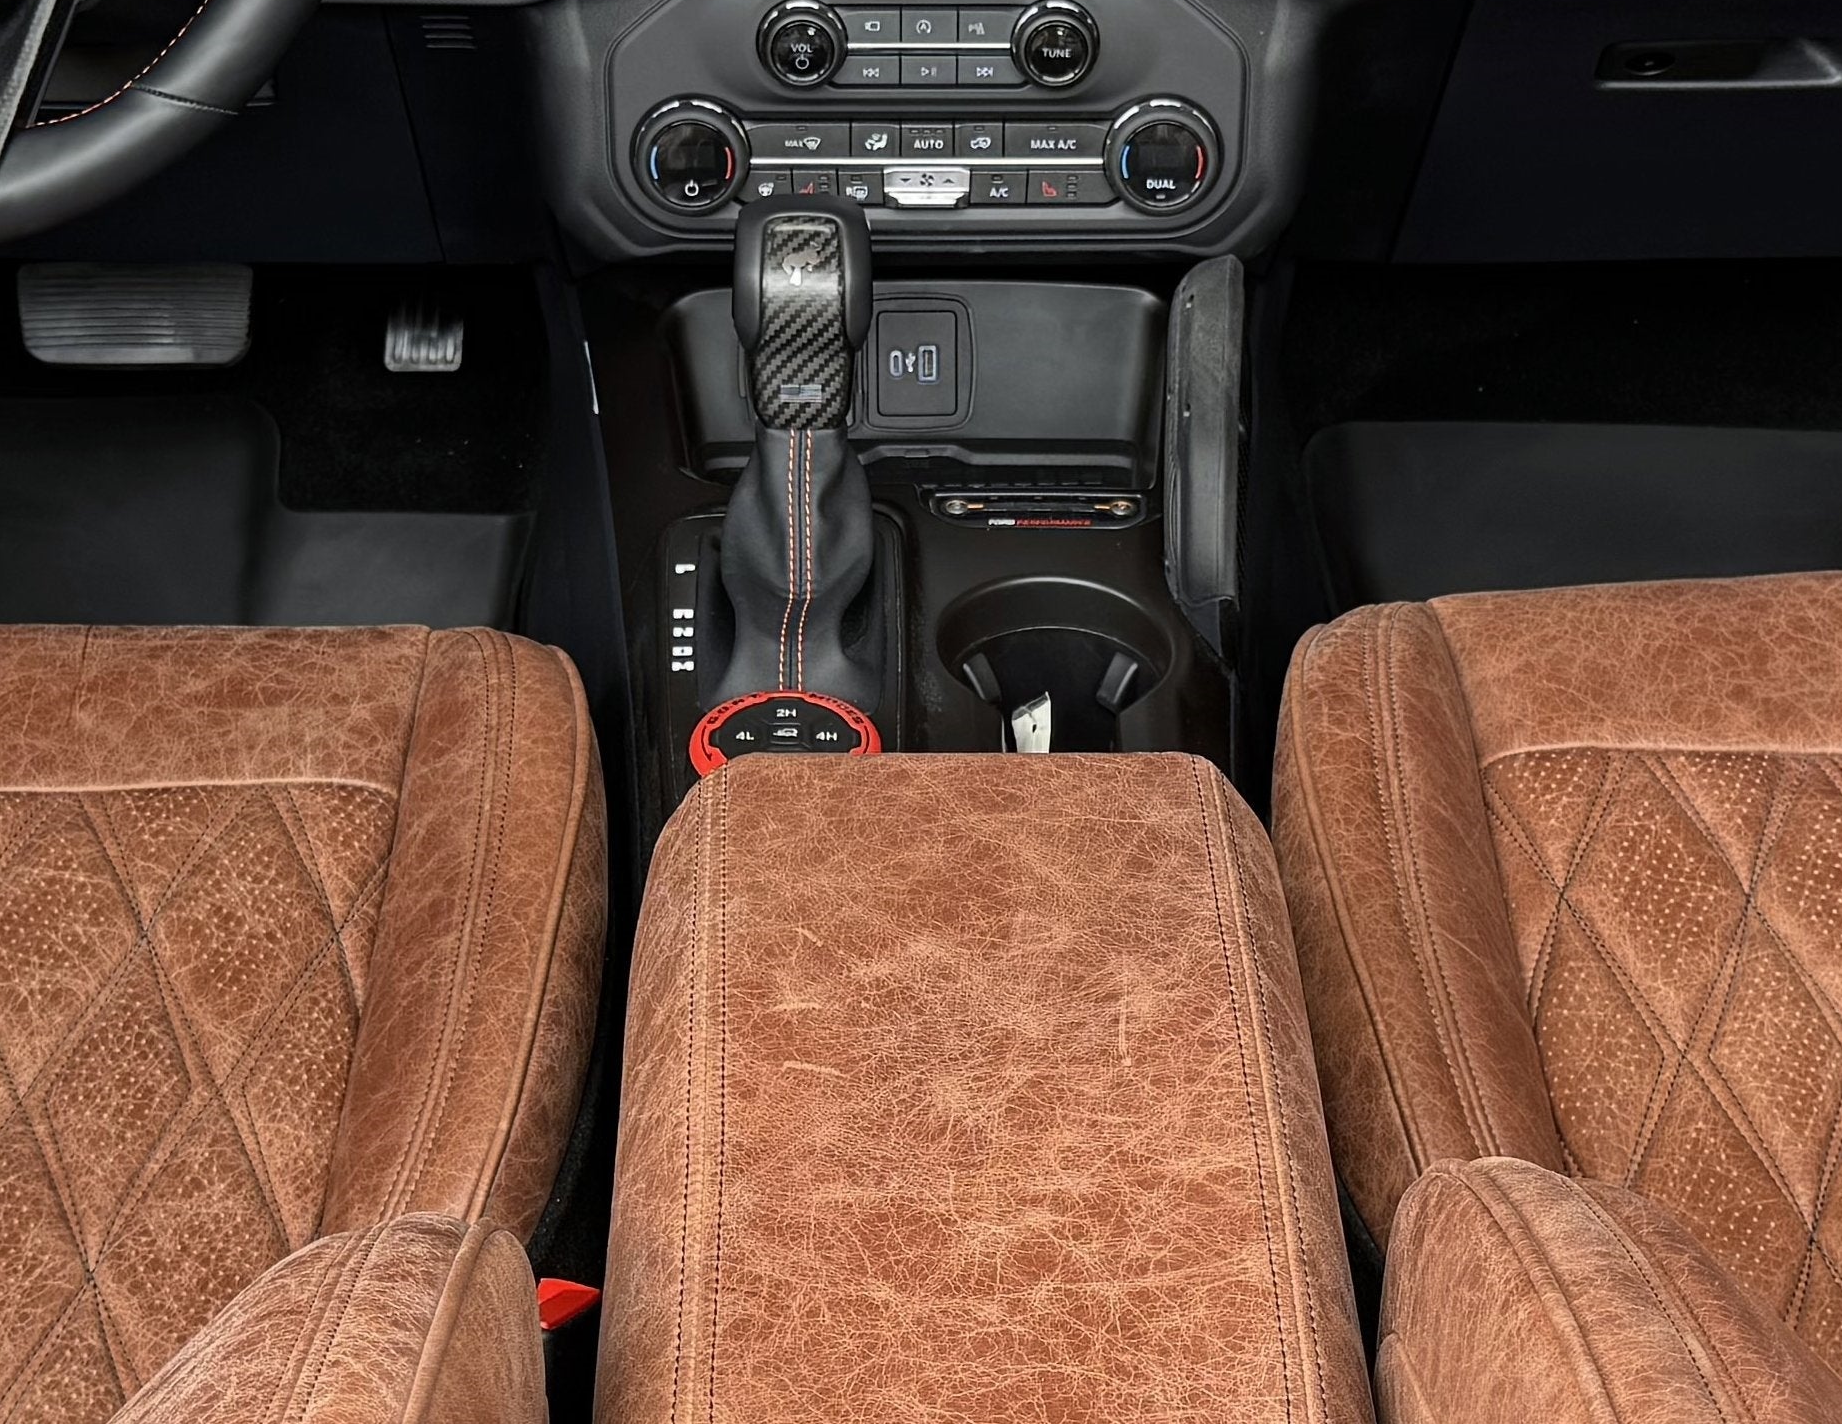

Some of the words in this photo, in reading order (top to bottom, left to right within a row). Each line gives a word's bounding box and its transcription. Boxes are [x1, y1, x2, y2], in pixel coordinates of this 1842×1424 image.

[790, 43, 814, 53] VOL
[1042, 48, 1072, 58] TUNE
[913, 139, 944, 149] AUTO
[1030, 139, 1055, 149] MAX
[1058, 139, 1077, 149] A/C
[1146, 179, 1176, 189] DUAL
[989, 187, 1009, 198] A/C
[776, 708, 797, 718] 2H
[735, 731, 755, 741] 4L
[815, 731, 838, 741] 4H
